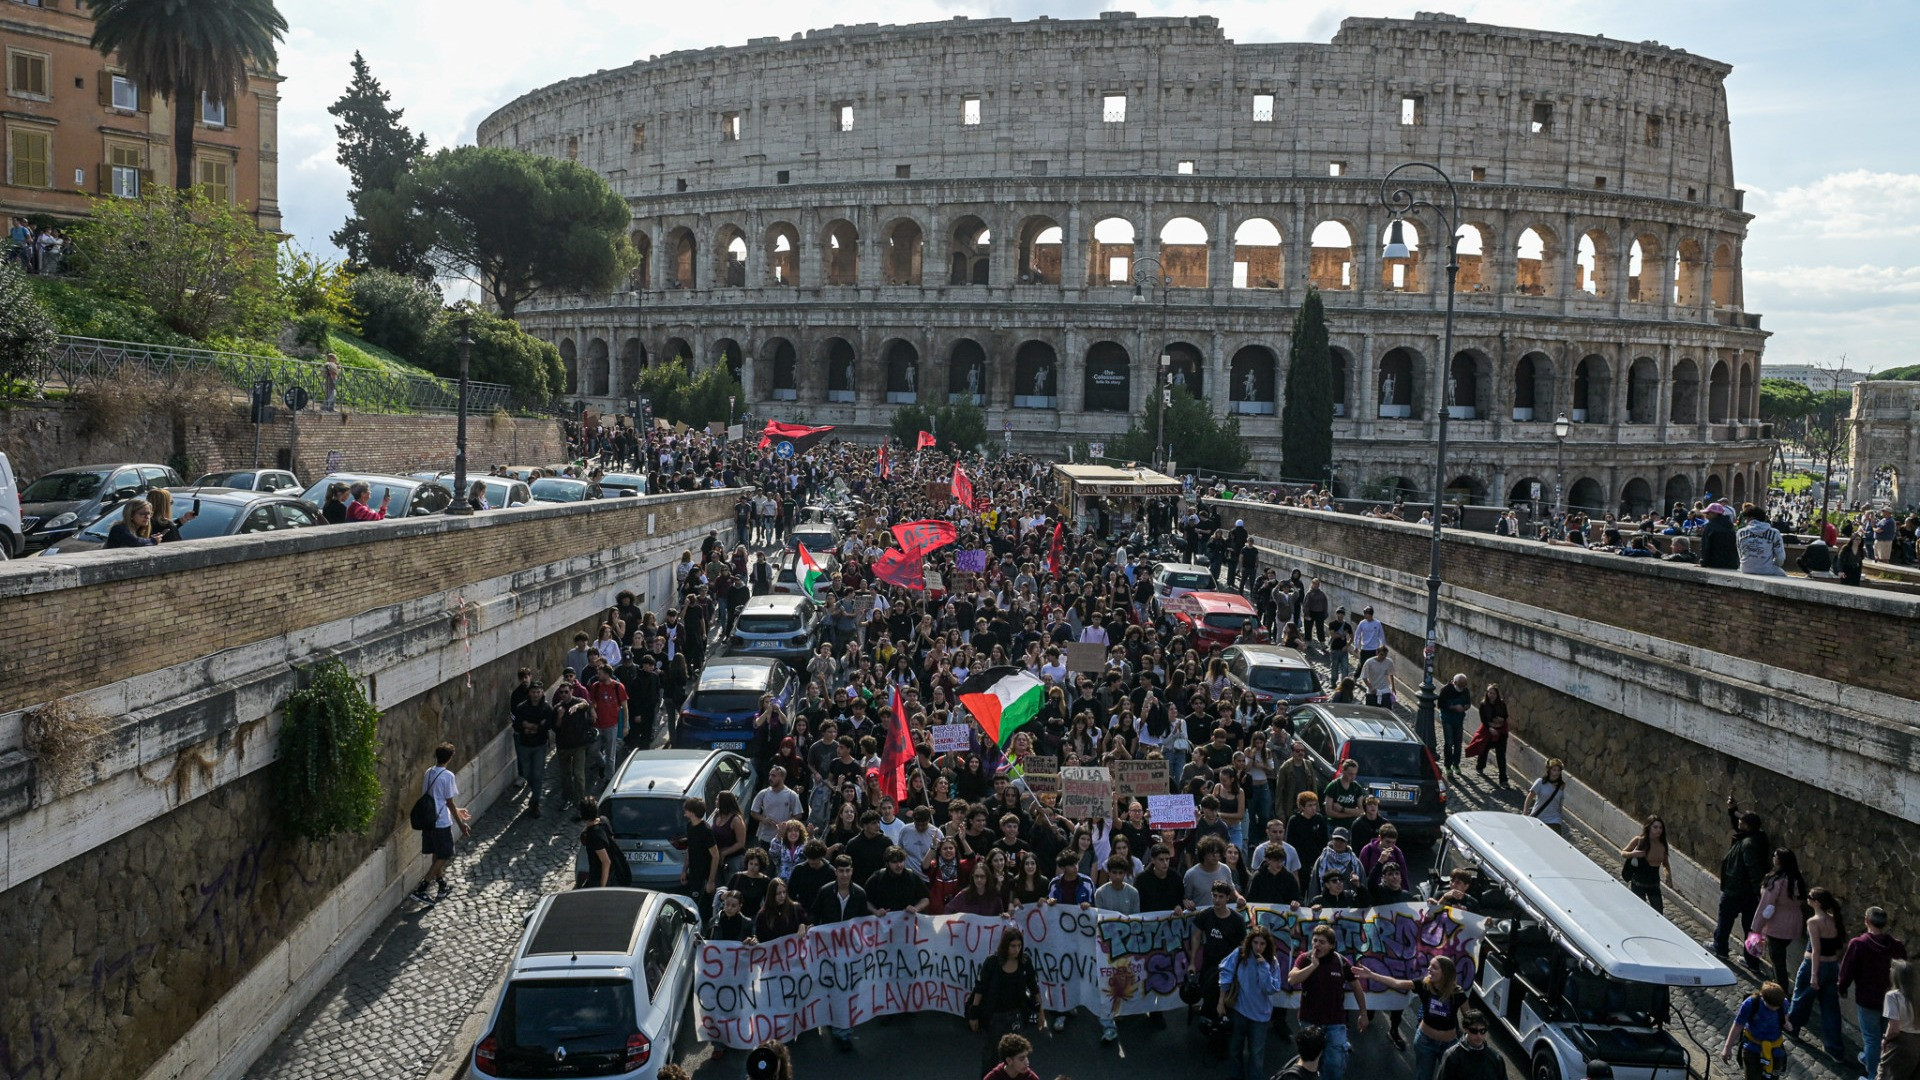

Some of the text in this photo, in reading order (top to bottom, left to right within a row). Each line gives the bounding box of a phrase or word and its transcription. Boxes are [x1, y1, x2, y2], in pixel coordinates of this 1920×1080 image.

[1118, 761, 1167, 771] SOTTOMESSA
[1119, 773, 1124, 782] A
[697, 973, 813, 1012] CONTRO
[848, 993, 864, 1027] E
